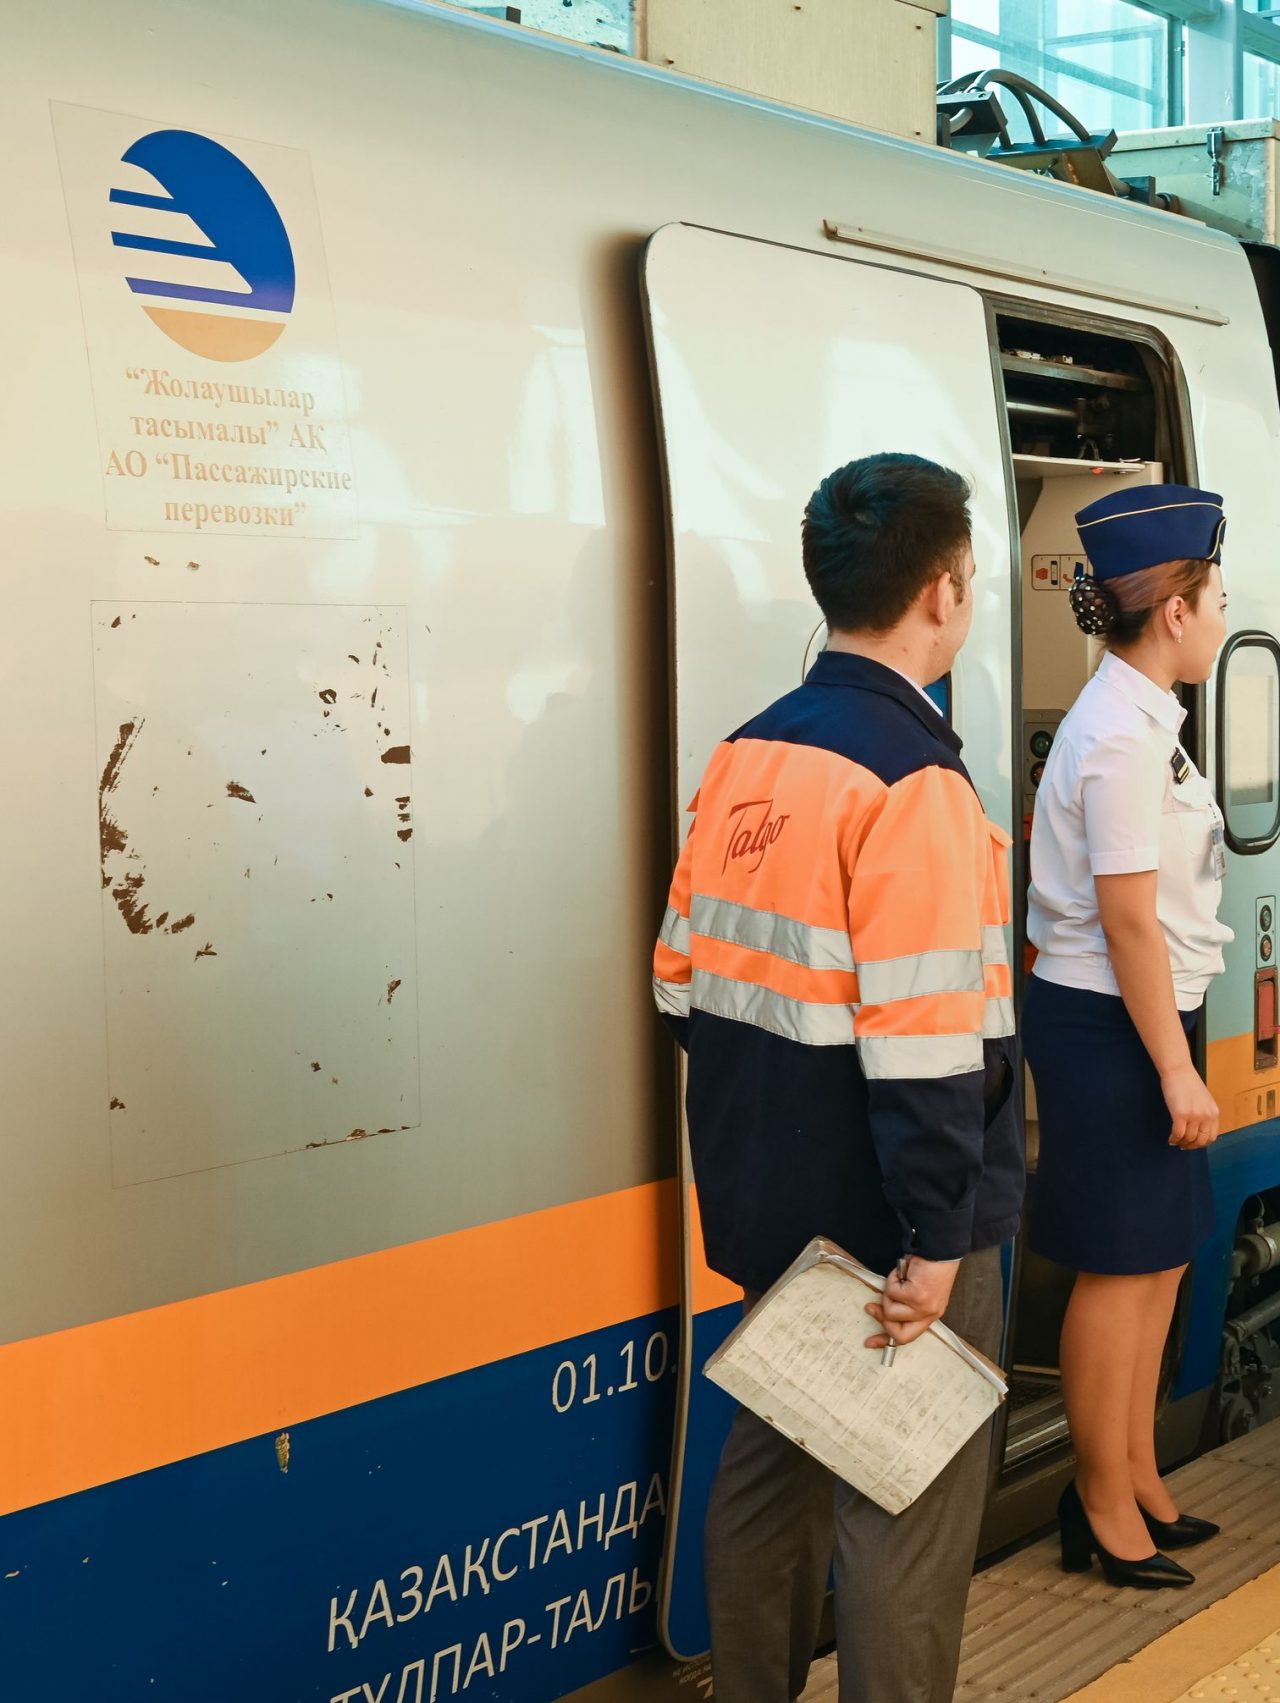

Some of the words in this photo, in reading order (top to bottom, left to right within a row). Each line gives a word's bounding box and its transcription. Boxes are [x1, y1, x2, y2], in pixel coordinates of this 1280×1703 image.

[105, 449, 148, 478] АО
[721, 798, 791, 876] Talgo
[327, 1472, 666, 1652] ҚАЗАҚСТАНДА
[329, 1558, 661, 1703] ЛПАР-ТАЛЬ
